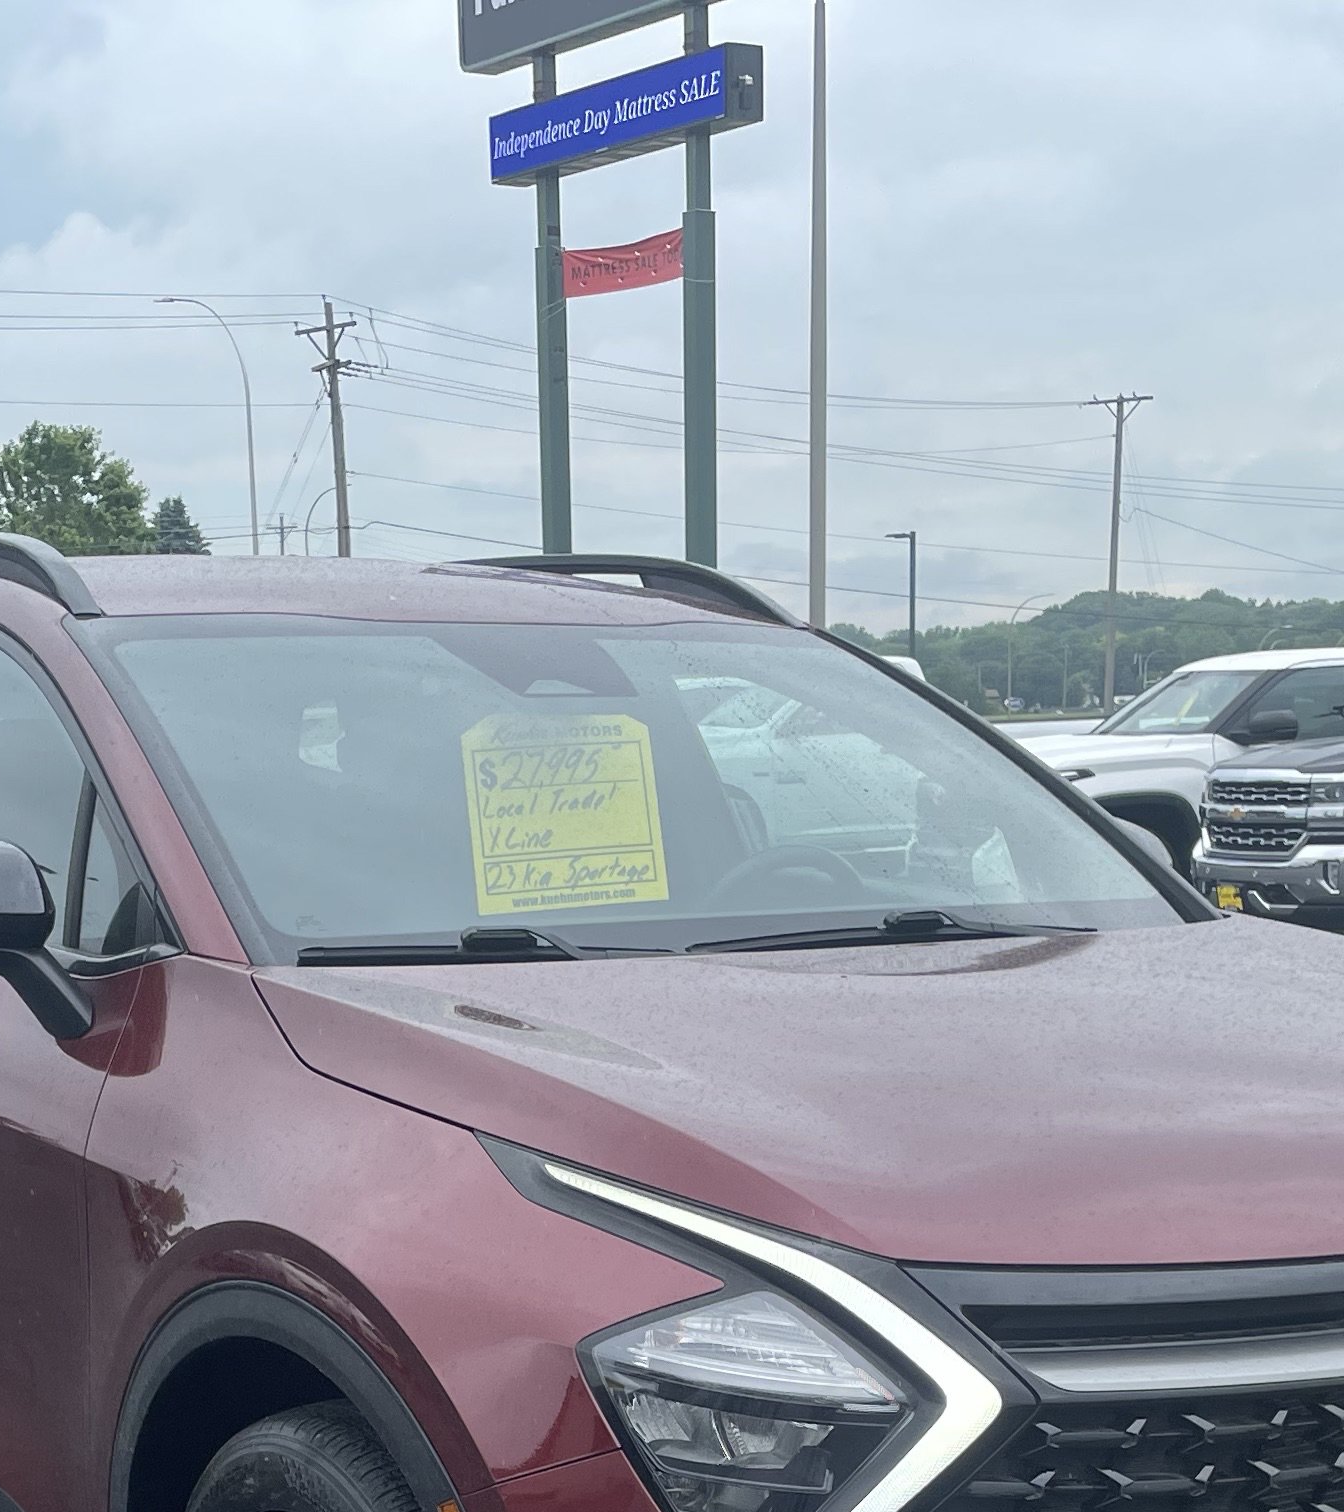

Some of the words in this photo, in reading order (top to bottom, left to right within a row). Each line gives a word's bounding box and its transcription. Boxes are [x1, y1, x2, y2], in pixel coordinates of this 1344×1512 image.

[493, 119, 580, 159] Independence
[583, 109, 611, 135] Day
[613, 88, 676, 124] Mattress
[679, 70, 721, 105] SALE
[571, 261, 630, 281] MATTRESS
[635, 254, 658, 272] SALE
[483, 792, 538, 819] Local
[487, 863, 516, 891] 23
[523, 862, 553, 889] Kia
[564, 855, 650, 891] Sportage
